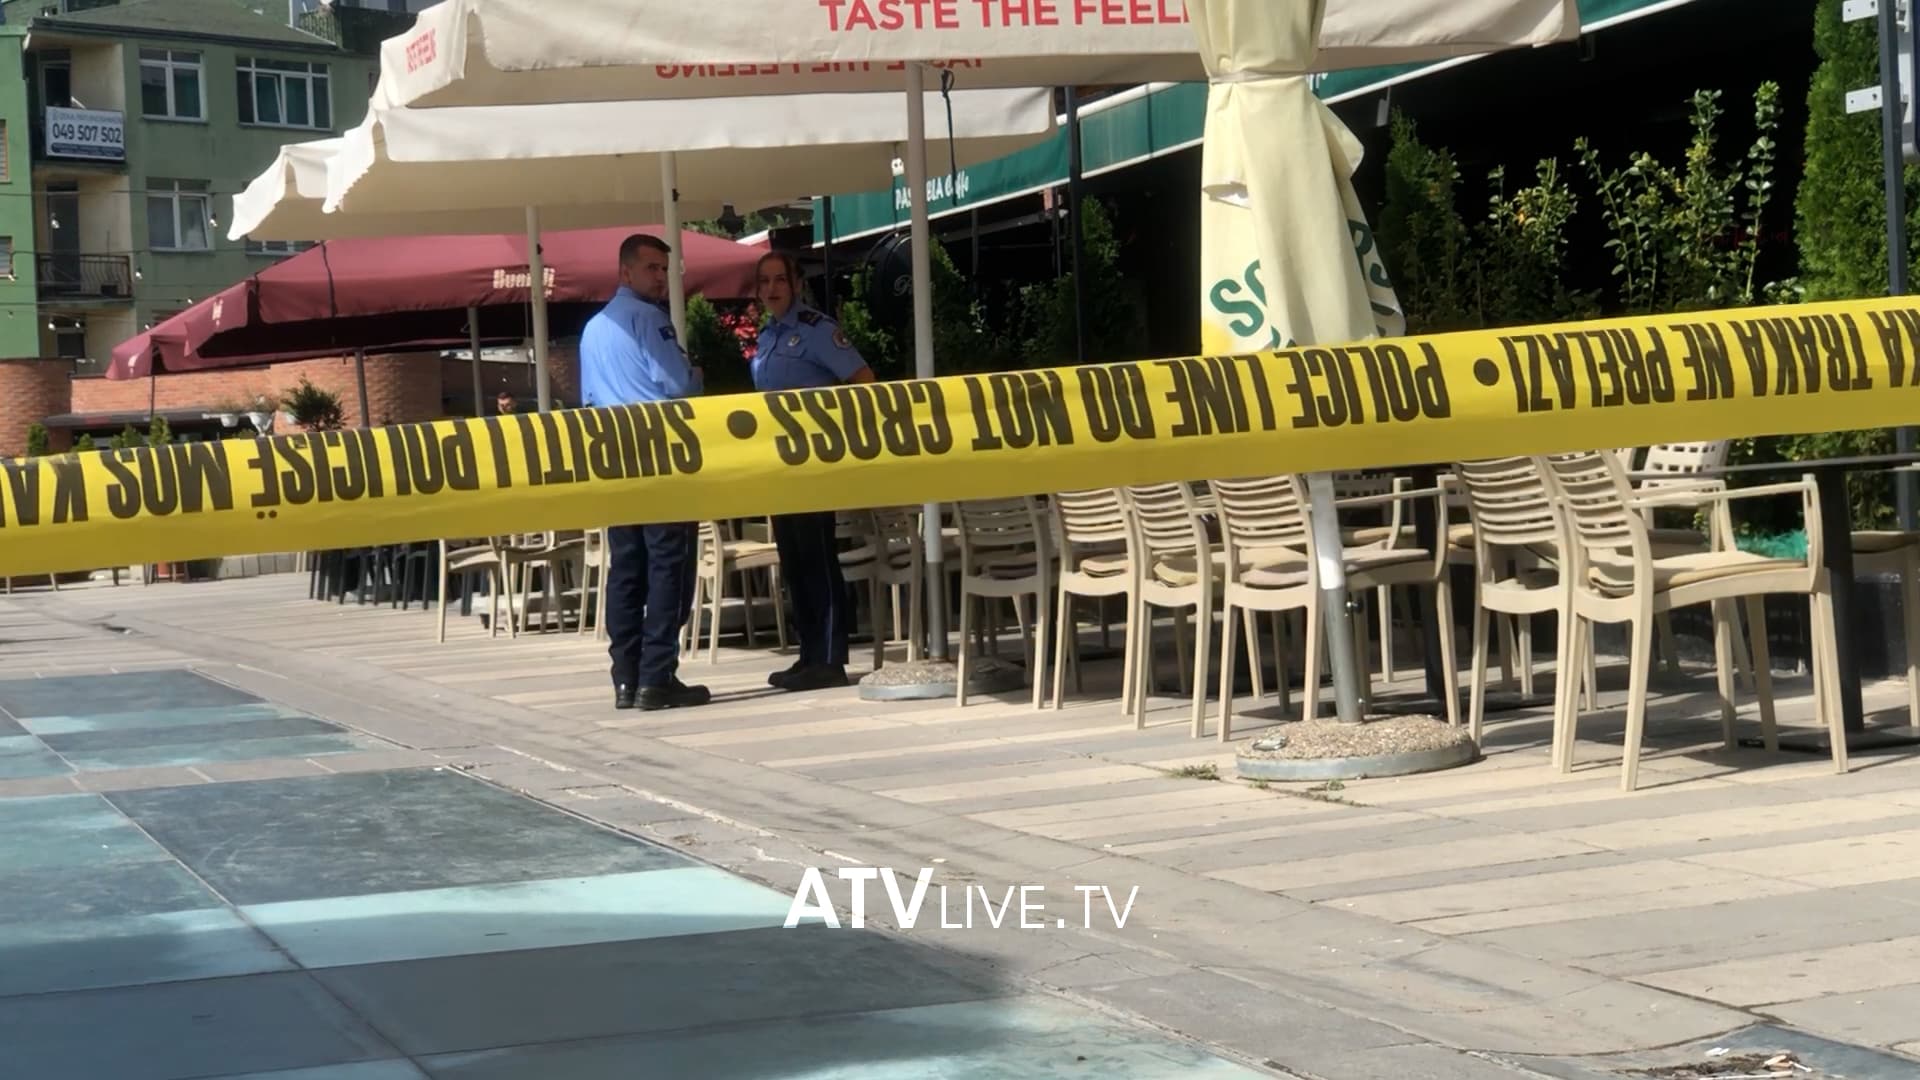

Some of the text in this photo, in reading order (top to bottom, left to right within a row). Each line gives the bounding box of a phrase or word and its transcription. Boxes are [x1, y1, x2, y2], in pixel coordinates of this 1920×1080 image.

[818, 0, 960, 31] TASTE
[972, 0, 1060, 28] THE
[52, 123, 122, 144] 049 507 502
[1154, 352, 1277, 437] LINE
[1273, 341, 1451, 428] POLICE
[1497, 326, 1675, 413] PRELAZI
[1668, 321, 1735, 402] NE
[1728, 312, 1873, 397] TRAKA
[517, 398, 704, 487] SHIRITI
[763, 379, 953, 466] CROSS
[964, 369, 1075, 451] NOT
[1076, 362, 1156, 442] DO
[0, 452, 89, 529] KA
[101, 440, 235, 520] MOS
[246, 418, 481, 520] POLICISË
[489, 415, 514, 489] I
